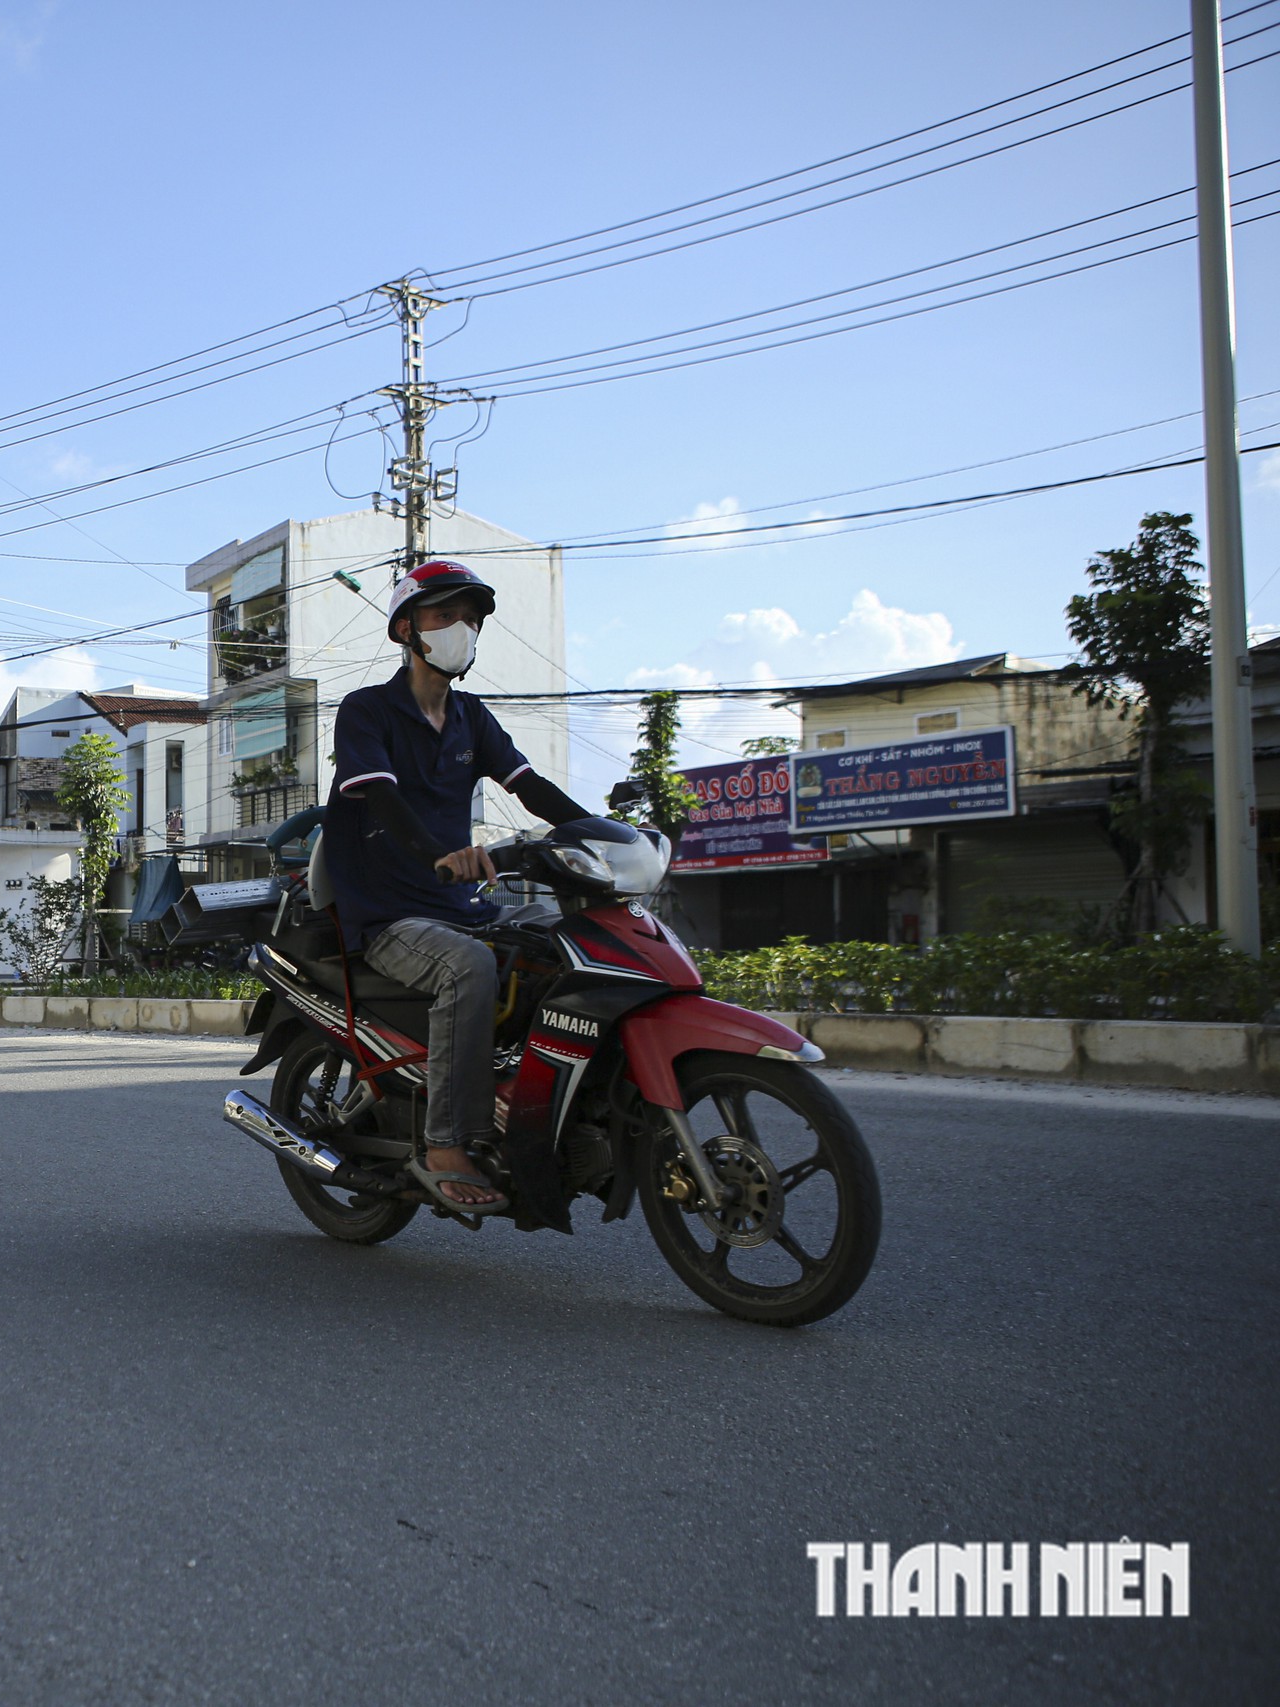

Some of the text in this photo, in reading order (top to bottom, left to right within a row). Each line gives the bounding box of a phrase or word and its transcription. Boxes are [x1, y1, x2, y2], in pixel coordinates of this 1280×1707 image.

[838, 756, 853, 767] CƠ
[855, 753, 873, 765] KHÍ
[910, 744, 945, 758] NHÔM
[953, 740, 982, 752] INOX
[725, 763, 754, 800] CỐ
[825, 752, 1006, 796] THẮNG NGUYỄN
[689, 807, 709, 822] Gas
[711, 802, 733, 820] Của
[735, 801, 756, 820] Mọi
[757, 797, 783, 816] Nhà
[542, 1008, 599, 1037] YAMAHA
